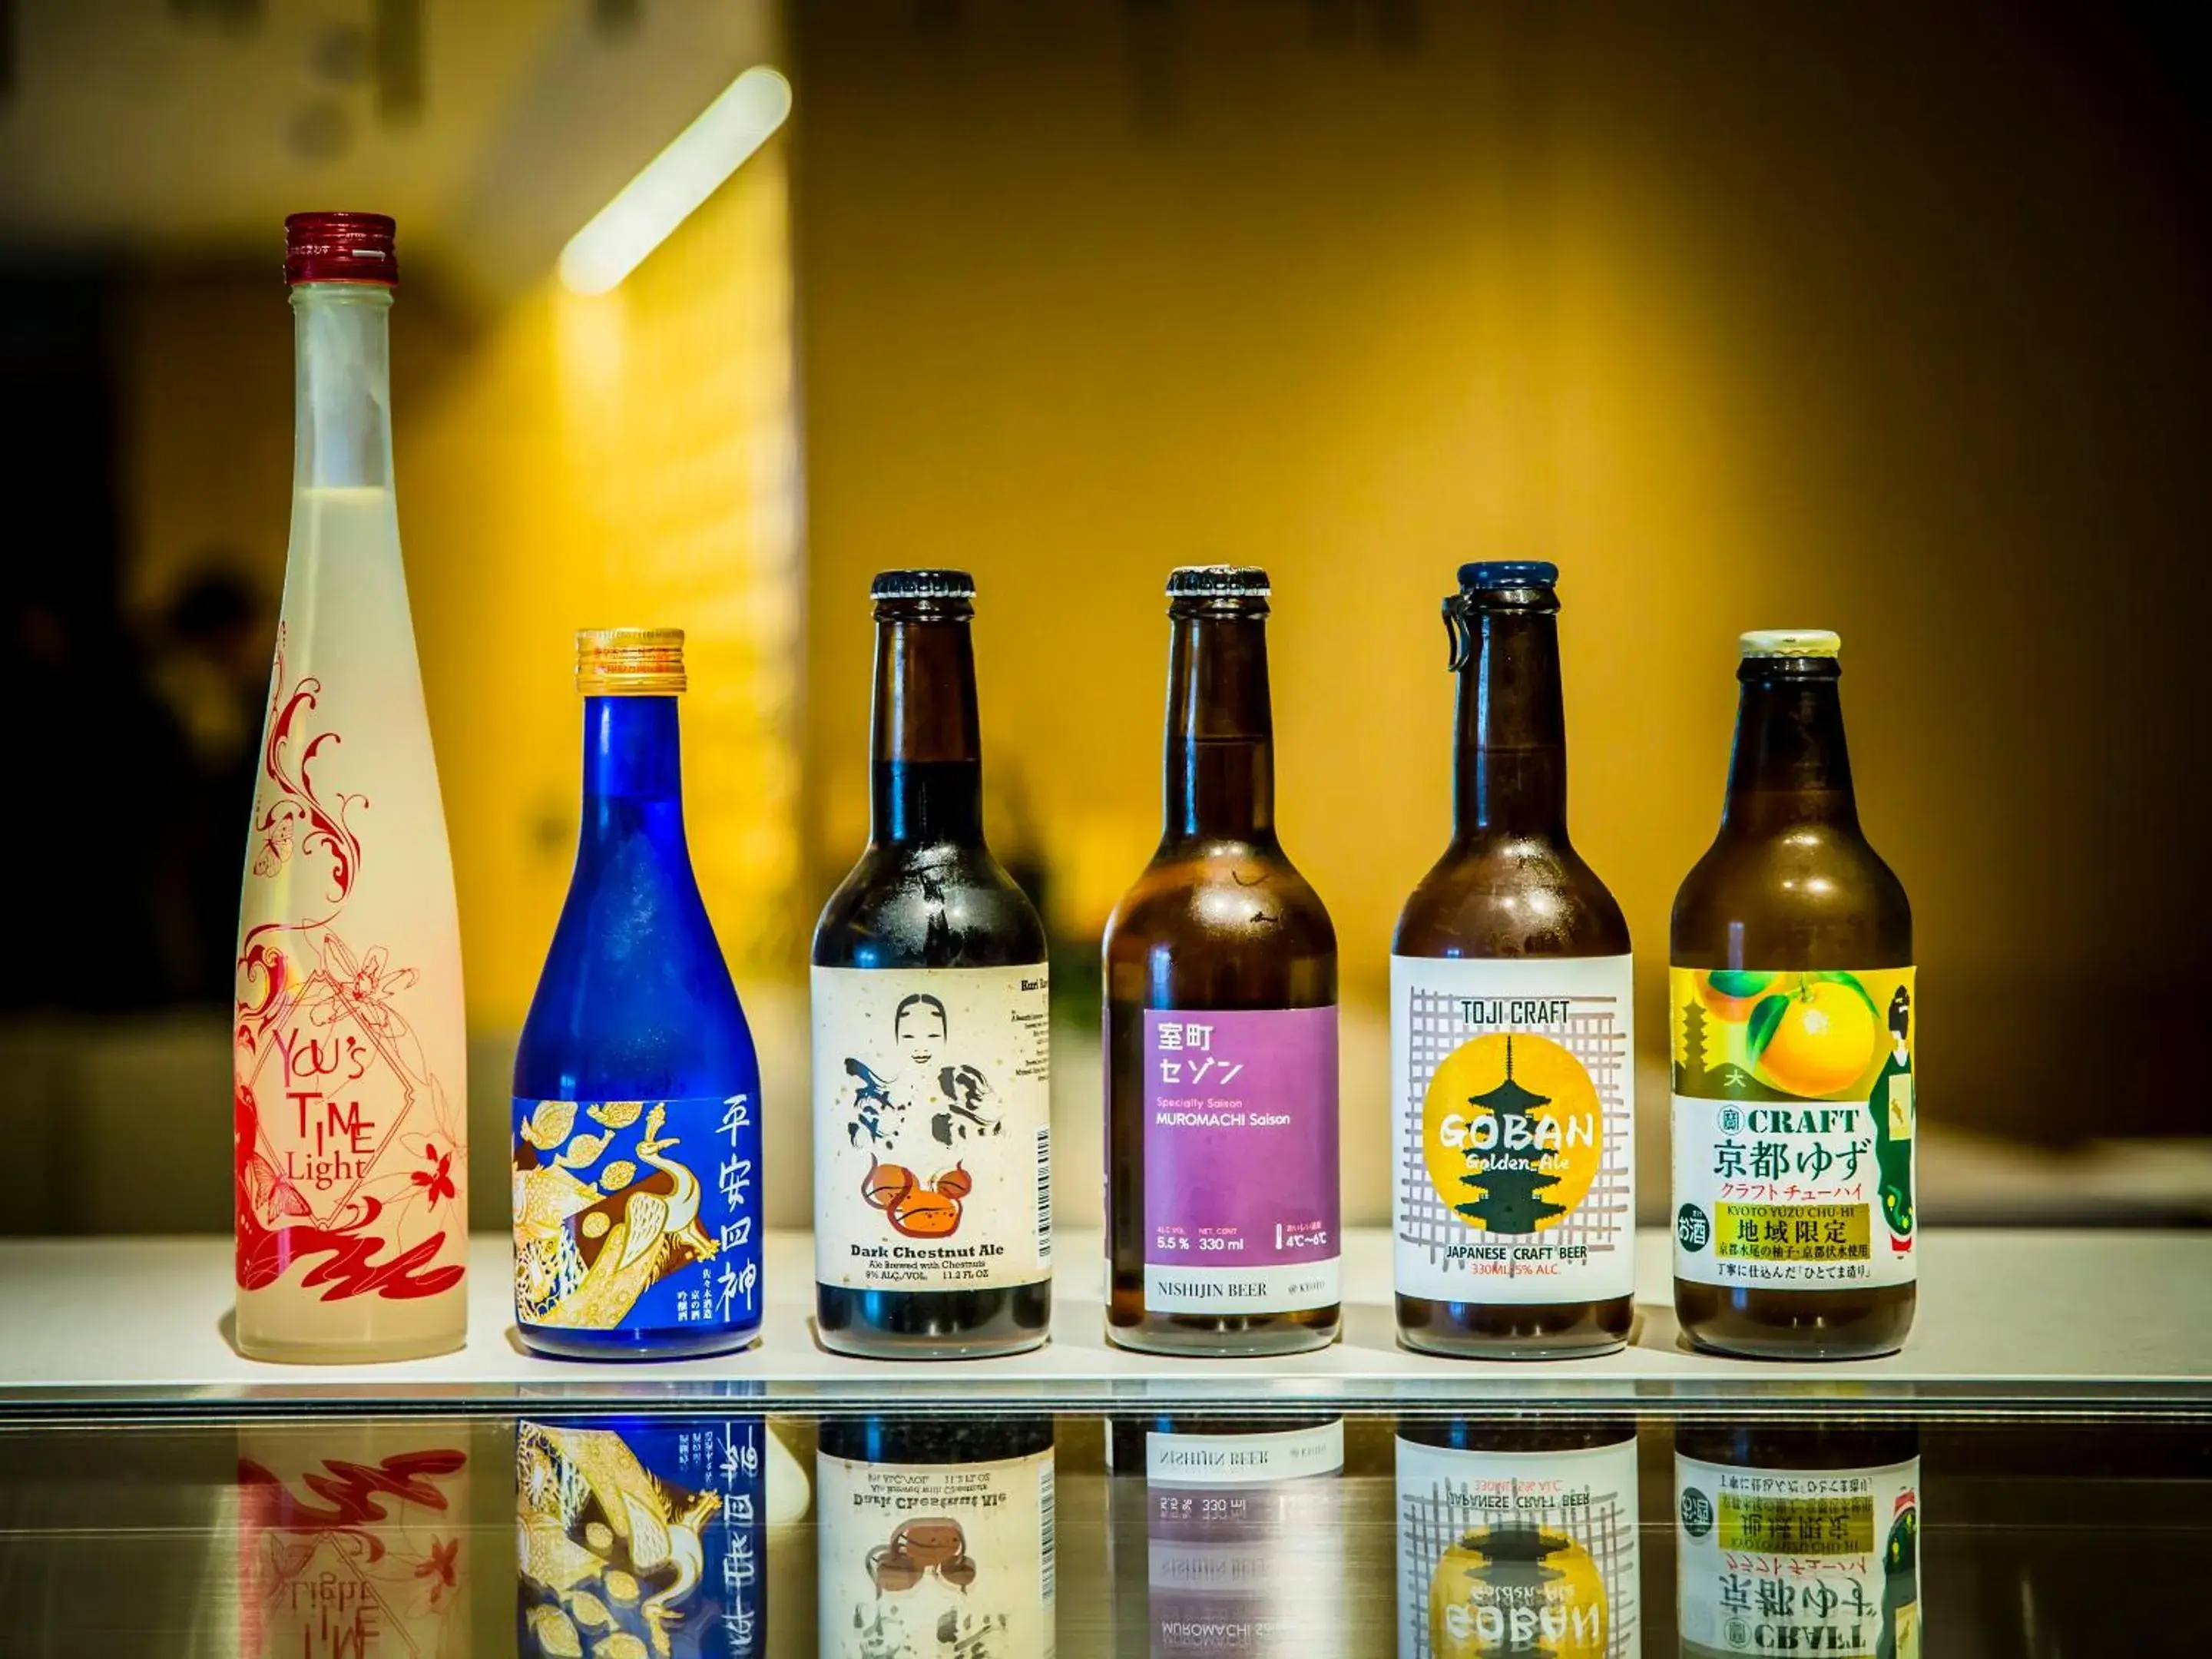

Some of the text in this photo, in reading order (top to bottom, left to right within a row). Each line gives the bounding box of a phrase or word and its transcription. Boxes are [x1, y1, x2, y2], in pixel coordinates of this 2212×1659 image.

[1462, 1001, 1570, 1025] TOJI CRAFT
[1157, 1022, 1214, 1051] 室町
[1159, 1056, 1244, 1085] セゾン
[1157, 1097, 1243, 1110] Specialty Saison
[286, 1091, 376, 1157] TIME
[1156, 1113, 1290, 1127] MUROMACHI Saison
[1440, 1113, 1594, 1151] GOBAN
[1747, 1109, 1859, 1134] CRAFT
[286, 1149, 367, 1190] Light
[1714, 1137, 1872, 1181] 京都ゆず
[1721, 1183, 1863, 1200] クラフトチューハイ
[714, 1093, 757, 1323] 平安四神
[1727, 1207, 1767, 1217] KYOTO
[1770, 1207, 1804, 1218] YUZU
[1679, 1216, 1706, 1244] お酒
[1737, 1219, 1847, 1243] 地域限定
[850, 1244, 1005, 1259] Dark Chestnut Ale
[1157, 1237, 1244, 1250] 5.5 % 330 ml
[1446, 1246, 1588, 1260] JAPANESE CRAFT BEER
[869, 1260, 882, 1269] Ale
[942, 1260, 986, 1269] Chestnuts
[942, 1270, 961, 1280] 11.2
[1158, 1282, 1267, 1298] NISHIJIN BEER
